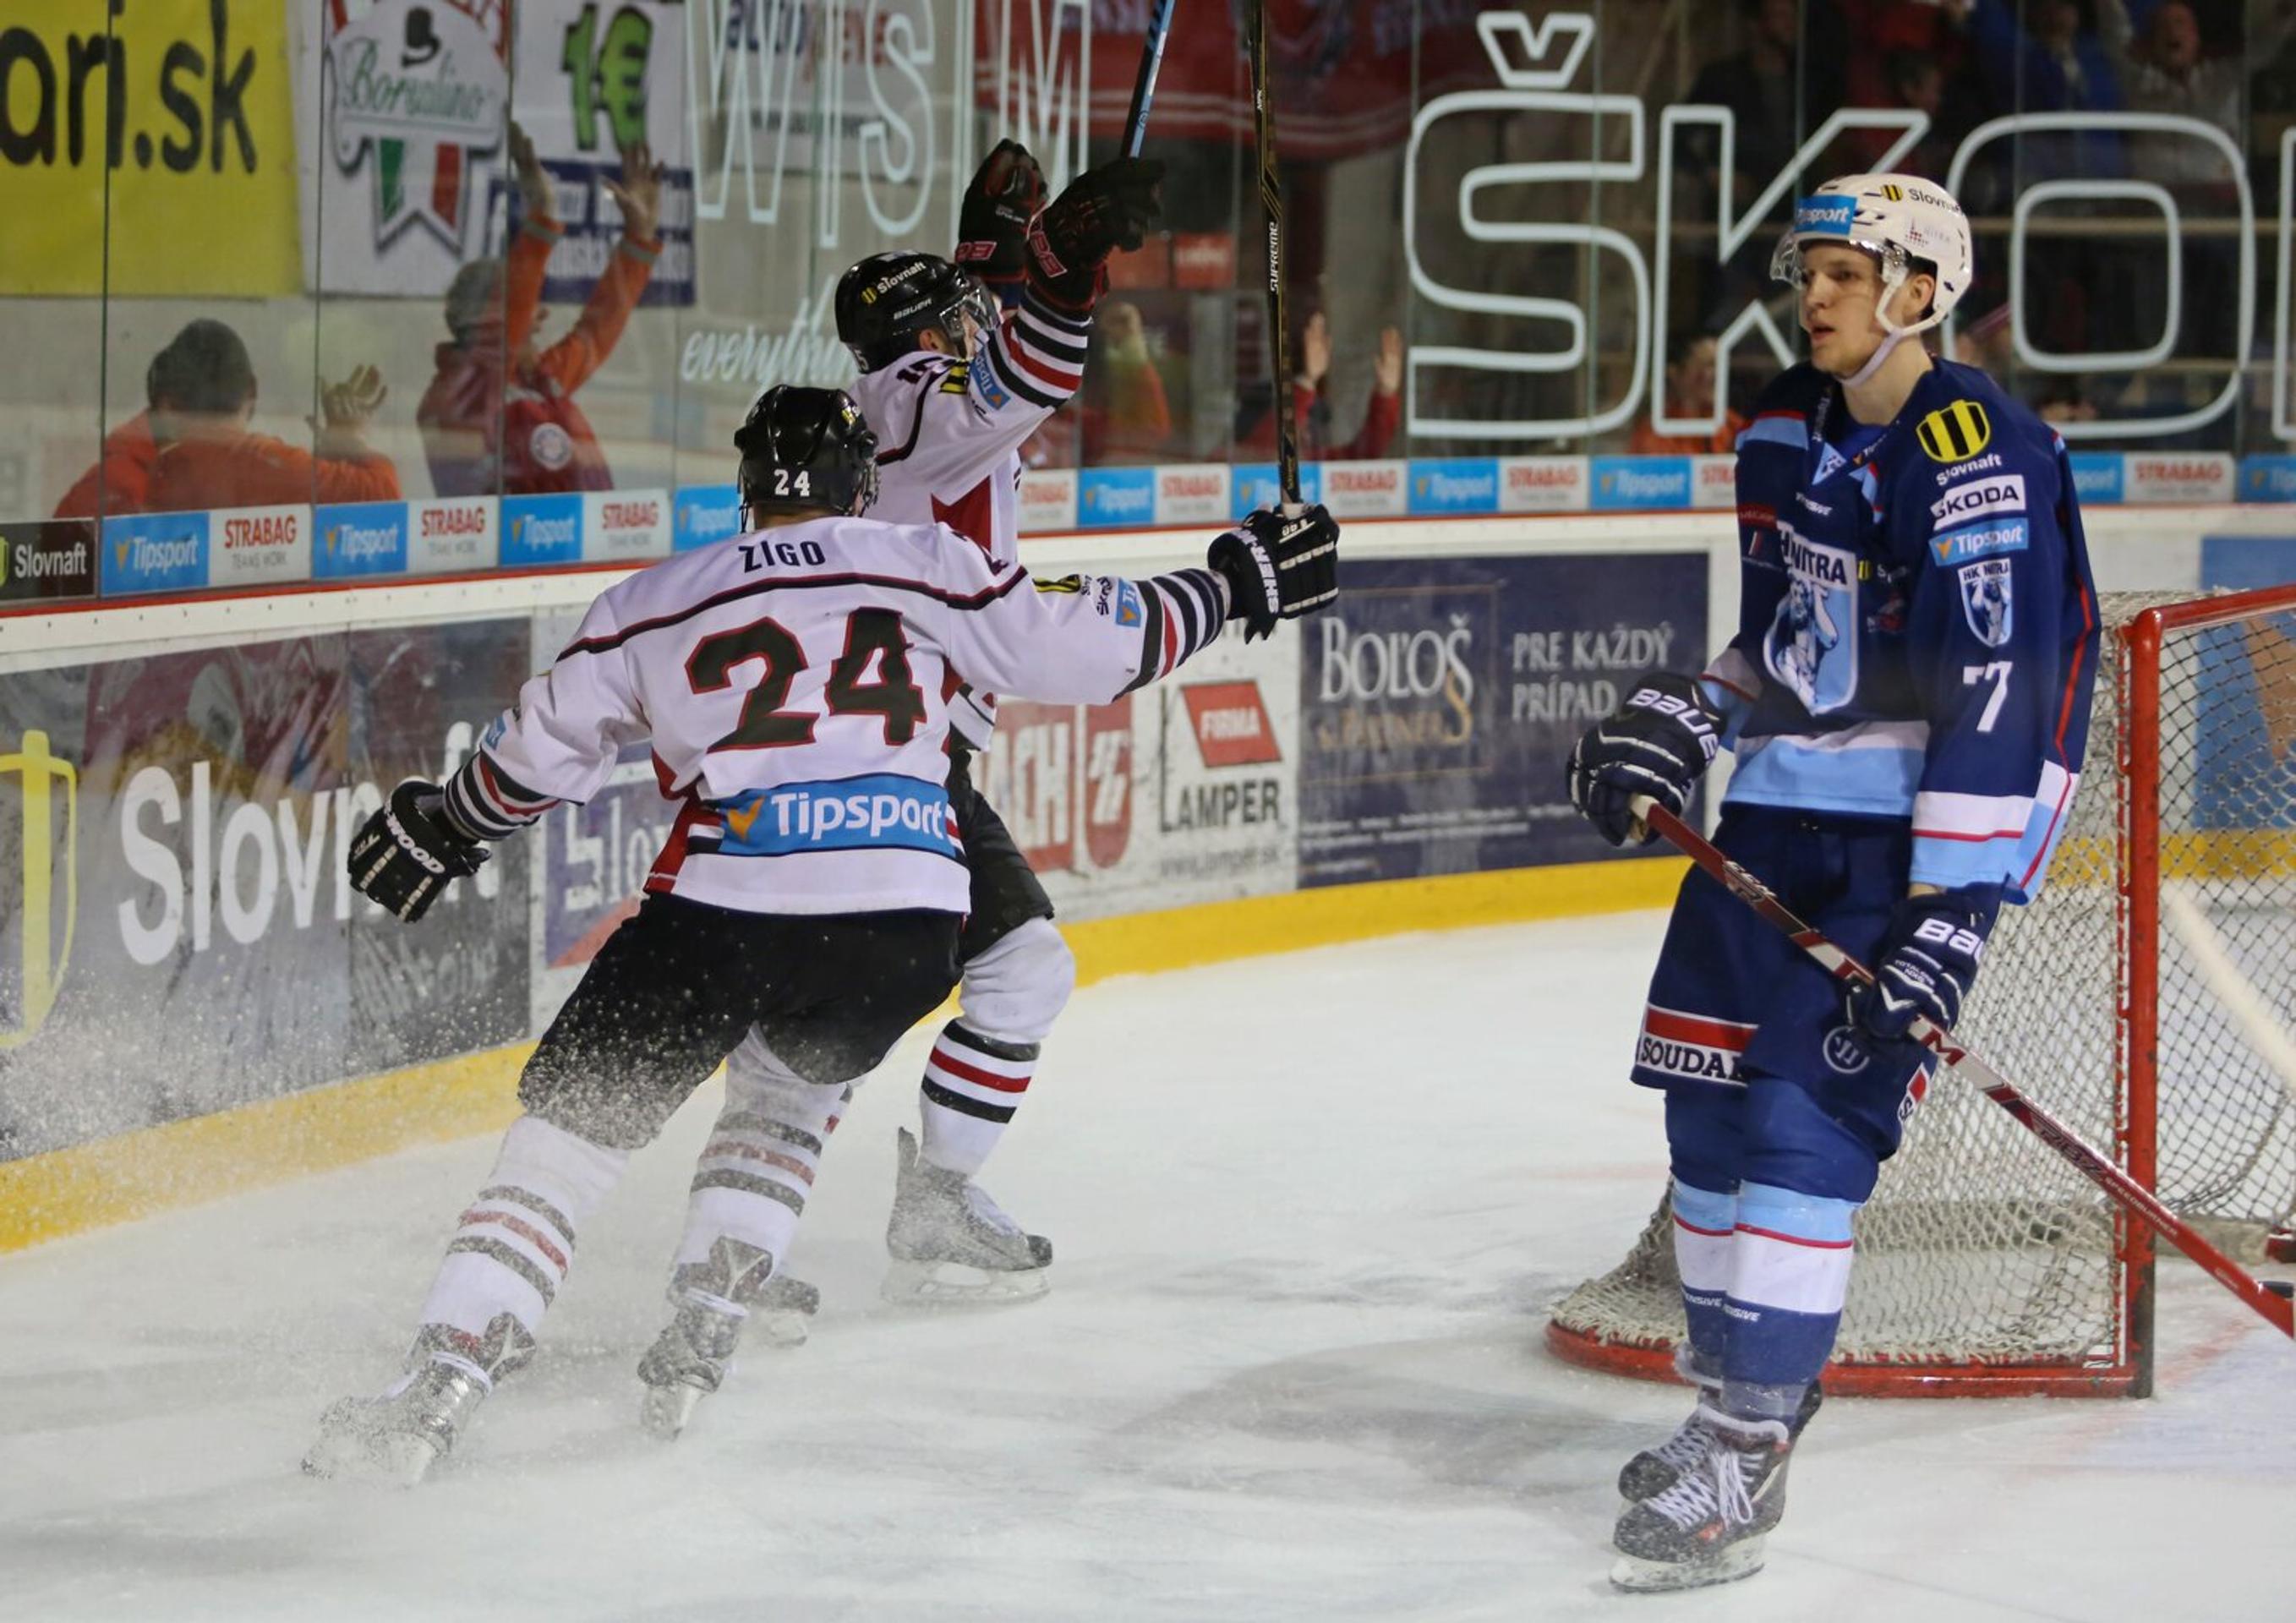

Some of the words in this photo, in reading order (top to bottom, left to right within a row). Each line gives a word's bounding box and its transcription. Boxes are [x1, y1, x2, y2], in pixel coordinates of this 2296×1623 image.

[1405, 12, 2296, 438] ŠKO
[877, 261, 927, 294] Slovnaft
[774, 468, 811, 497] 24
[1936, 453, 2002, 486] Slovnaft
[224, 514, 298, 549] STRABAG
[421, 507, 485, 538] STRABAG
[522, 512, 576, 550] Tipsport
[601, 502, 659, 530] STRABAG
[133, 533, 199, 577] Tipsport
[339, 522, 398, 561] Tipsport
[738, 540, 826, 573] ZIGO
[1955, 525, 2023, 555] Tipsport
[14, 541, 88, 579] Slovnaft
[1512, 631, 1562, 671] PRE
[1572, 622, 1675, 669] KAŽDÝ
[684, 605, 928, 755] 24
[1963, 661, 2014, 732] 7
[1512, 679, 1619, 722] PRÍPAD
[1626, 688, 1719, 767] BAUE
[770, 791, 945, 841] Tipsport
